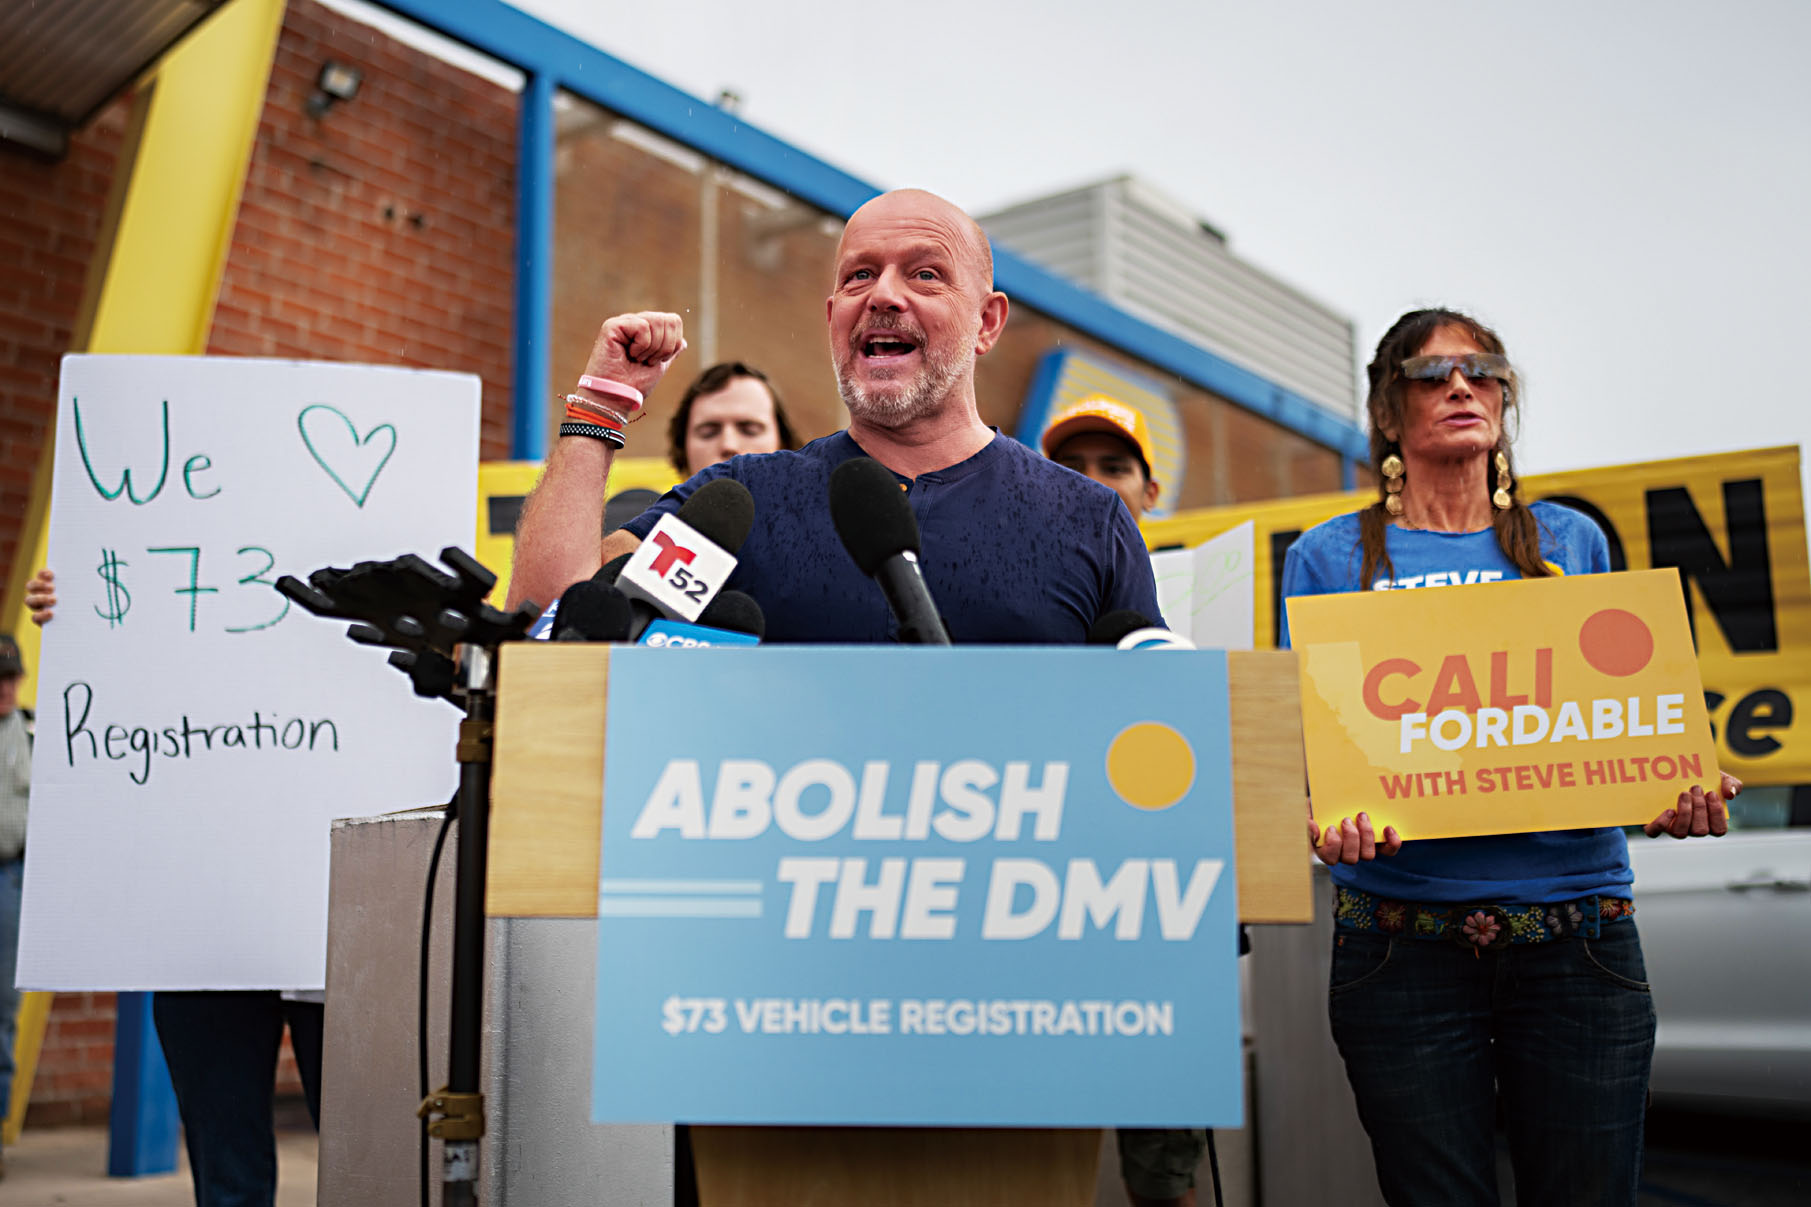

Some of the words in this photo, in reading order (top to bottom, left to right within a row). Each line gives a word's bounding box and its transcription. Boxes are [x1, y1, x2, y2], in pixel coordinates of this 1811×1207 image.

[73, 396, 222, 505] We
[669, 567, 709, 604] 52
[1362, 647, 1553, 722] CALI
[64, 682, 338, 785] Registration
[1400, 693, 1686, 754] FORDABLE
[630, 758, 1070, 842] ABOLISH
[1379, 769, 1468, 800] WITH
[1476, 762, 1577, 794] STEVE
[1583, 753, 1704, 787] HILTON
[777, 857, 966, 940] THE
[981, 858, 1225, 941] DMV
[661, 994, 728, 1037] $73
[734, 999, 892, 1036] VEHICLE
[901, 1000, 1174, 1037] REGISTRATION
